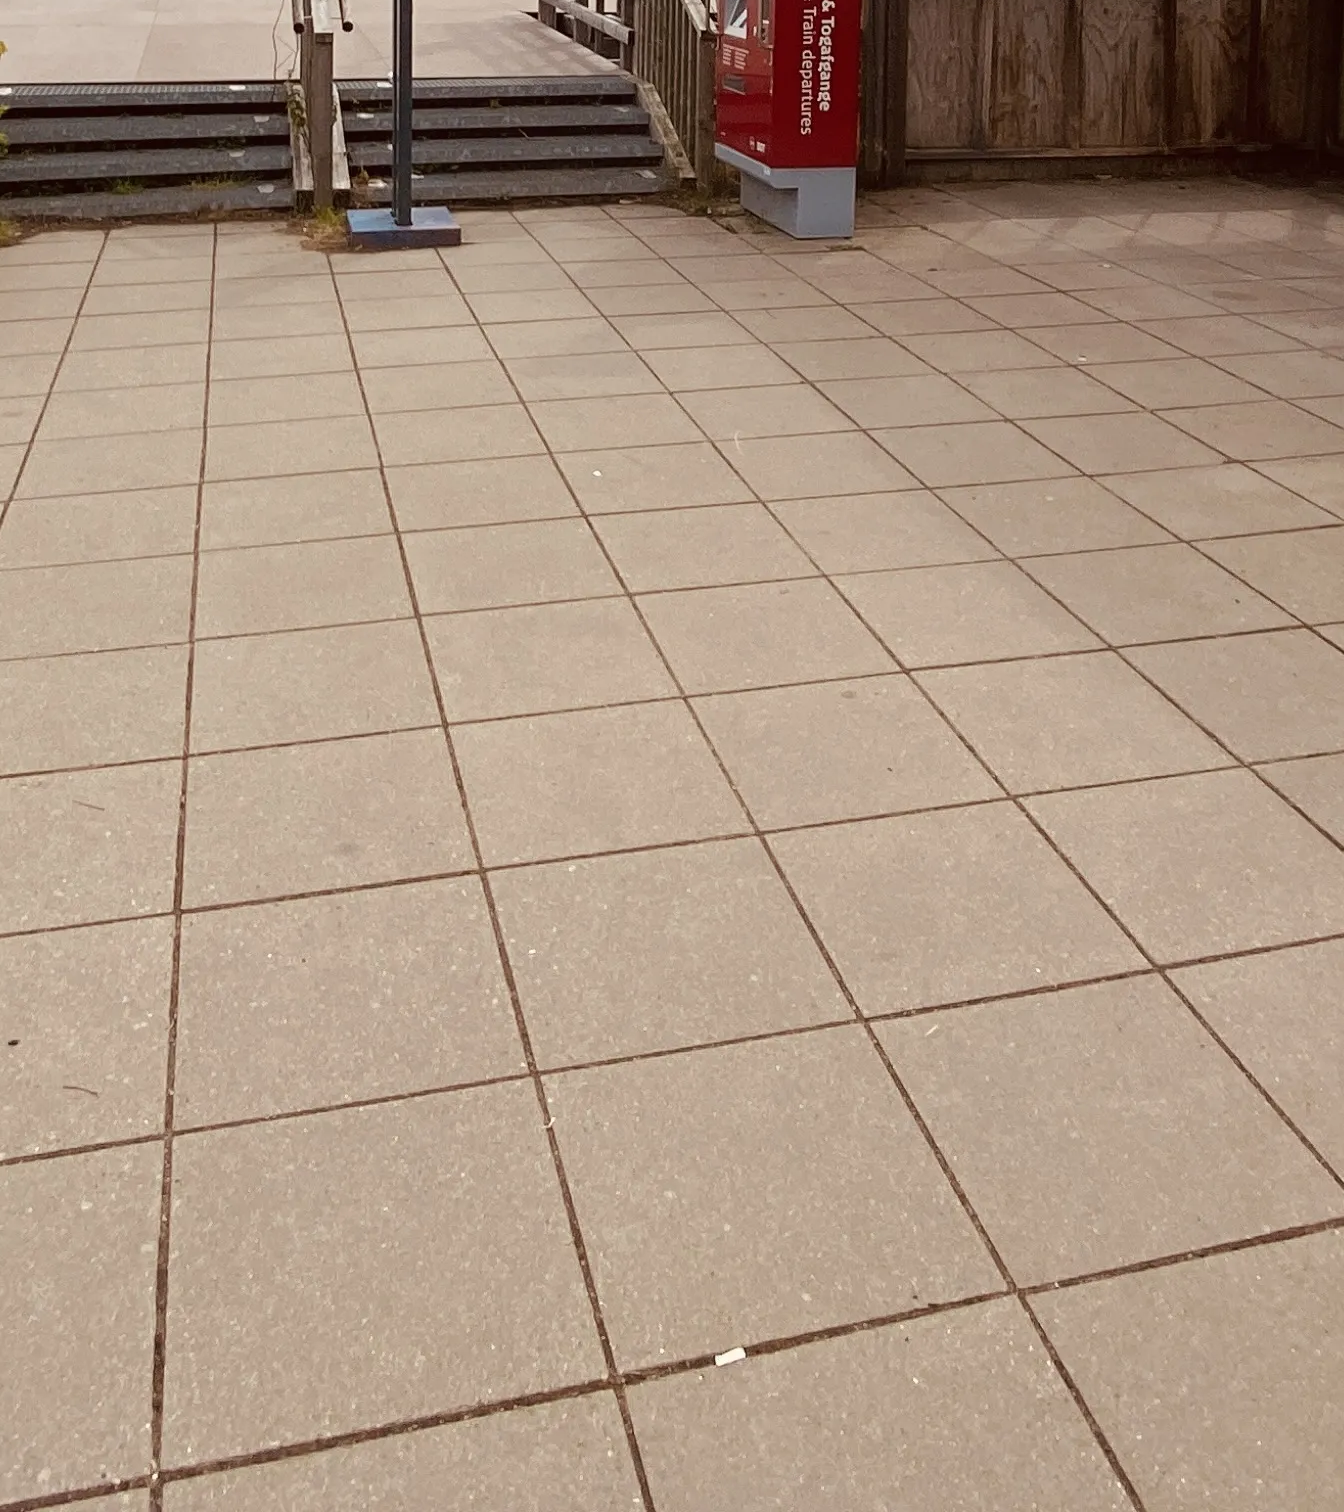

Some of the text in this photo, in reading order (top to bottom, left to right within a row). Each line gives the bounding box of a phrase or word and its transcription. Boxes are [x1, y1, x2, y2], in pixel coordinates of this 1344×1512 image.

[802, 5, 817, 45] Train
[821, 0, 836, 13] &
[799, 49, 817, 136] departures
[816, 15, 835, 112] Togafgange
